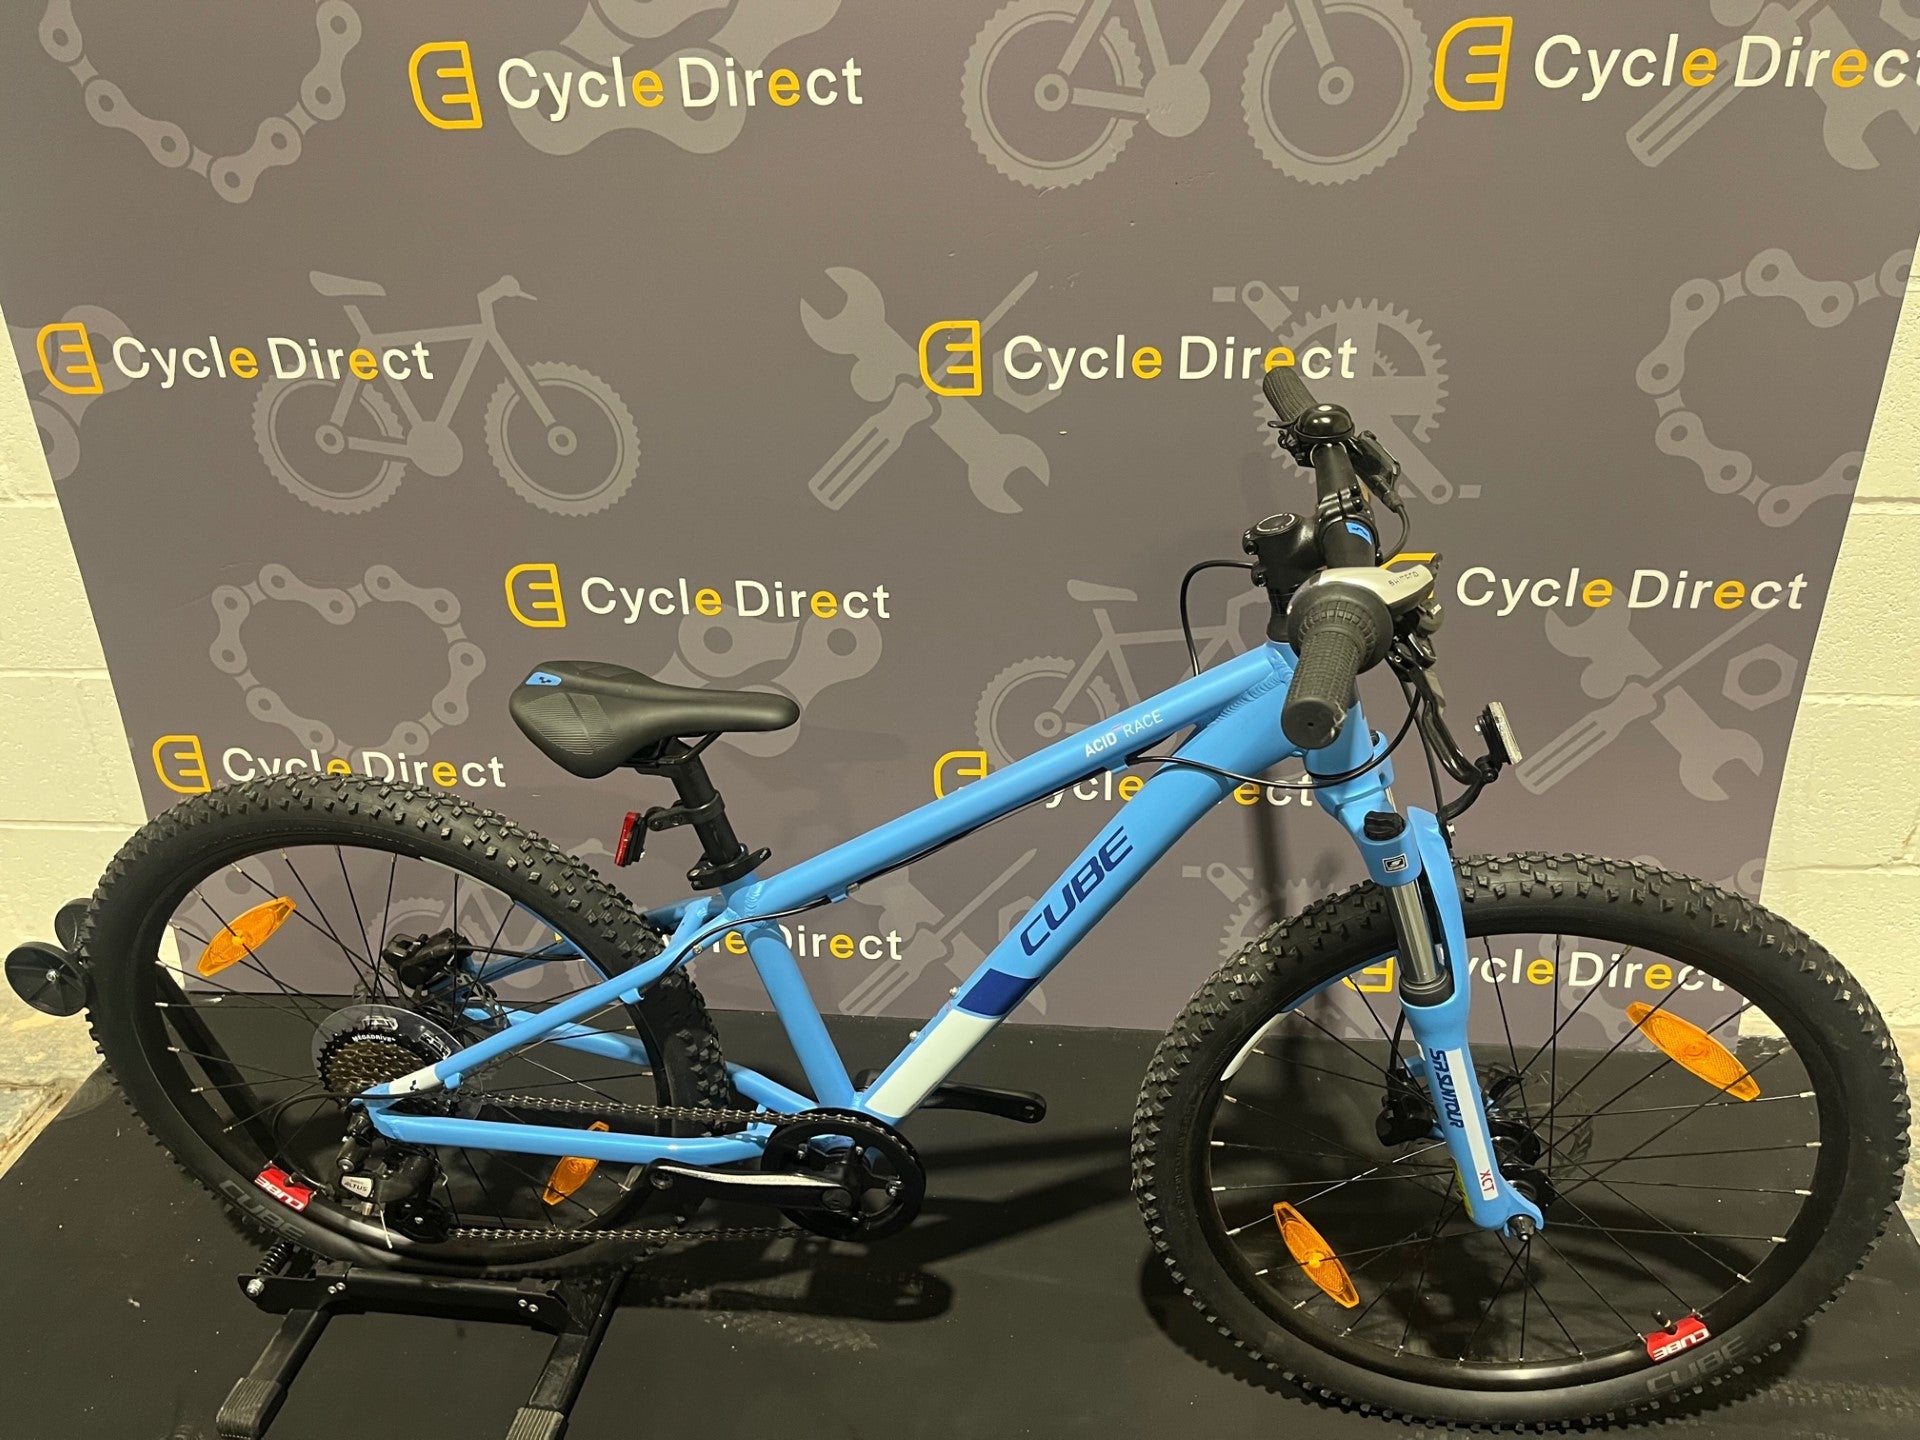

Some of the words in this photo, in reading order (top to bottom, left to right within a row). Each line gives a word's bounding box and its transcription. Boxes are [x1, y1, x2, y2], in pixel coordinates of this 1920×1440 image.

[498, 57, 665, 122] Cycle
[678, 56, 863, 108] Direct
[1534, 33, 1718, 102] Cycle
[112, 335, 259, 389] Cycle
[267, 337, 434, 381] Direct
[1003, 334, 1163, 391] Cycle
[1179, 335, 1358, 380] Direct
[581, 576, 723, 624] Cycle
[735, 580, 890, 619] Direct
[1456, 566, 1614, 617] Cycle
[1627, 569, 1808, 610] Direct
[1084, 732, 1118, 758] ACID
[1122, 710, 1163, 738] RACE
[362, 751, 507, 788] Direct
[1046, 770, 1144, 809] cle
[1020, 825, 1134, 957] CUBE
[779, 924, 902, 961] irect
[1468, 948, 1554, 985] cle
[1479, 1168, 1495, 1192] XCT
[1646, 1335, 1745, 1394] CUBE
[1653, 1328, 1710, 1361] CUBE
